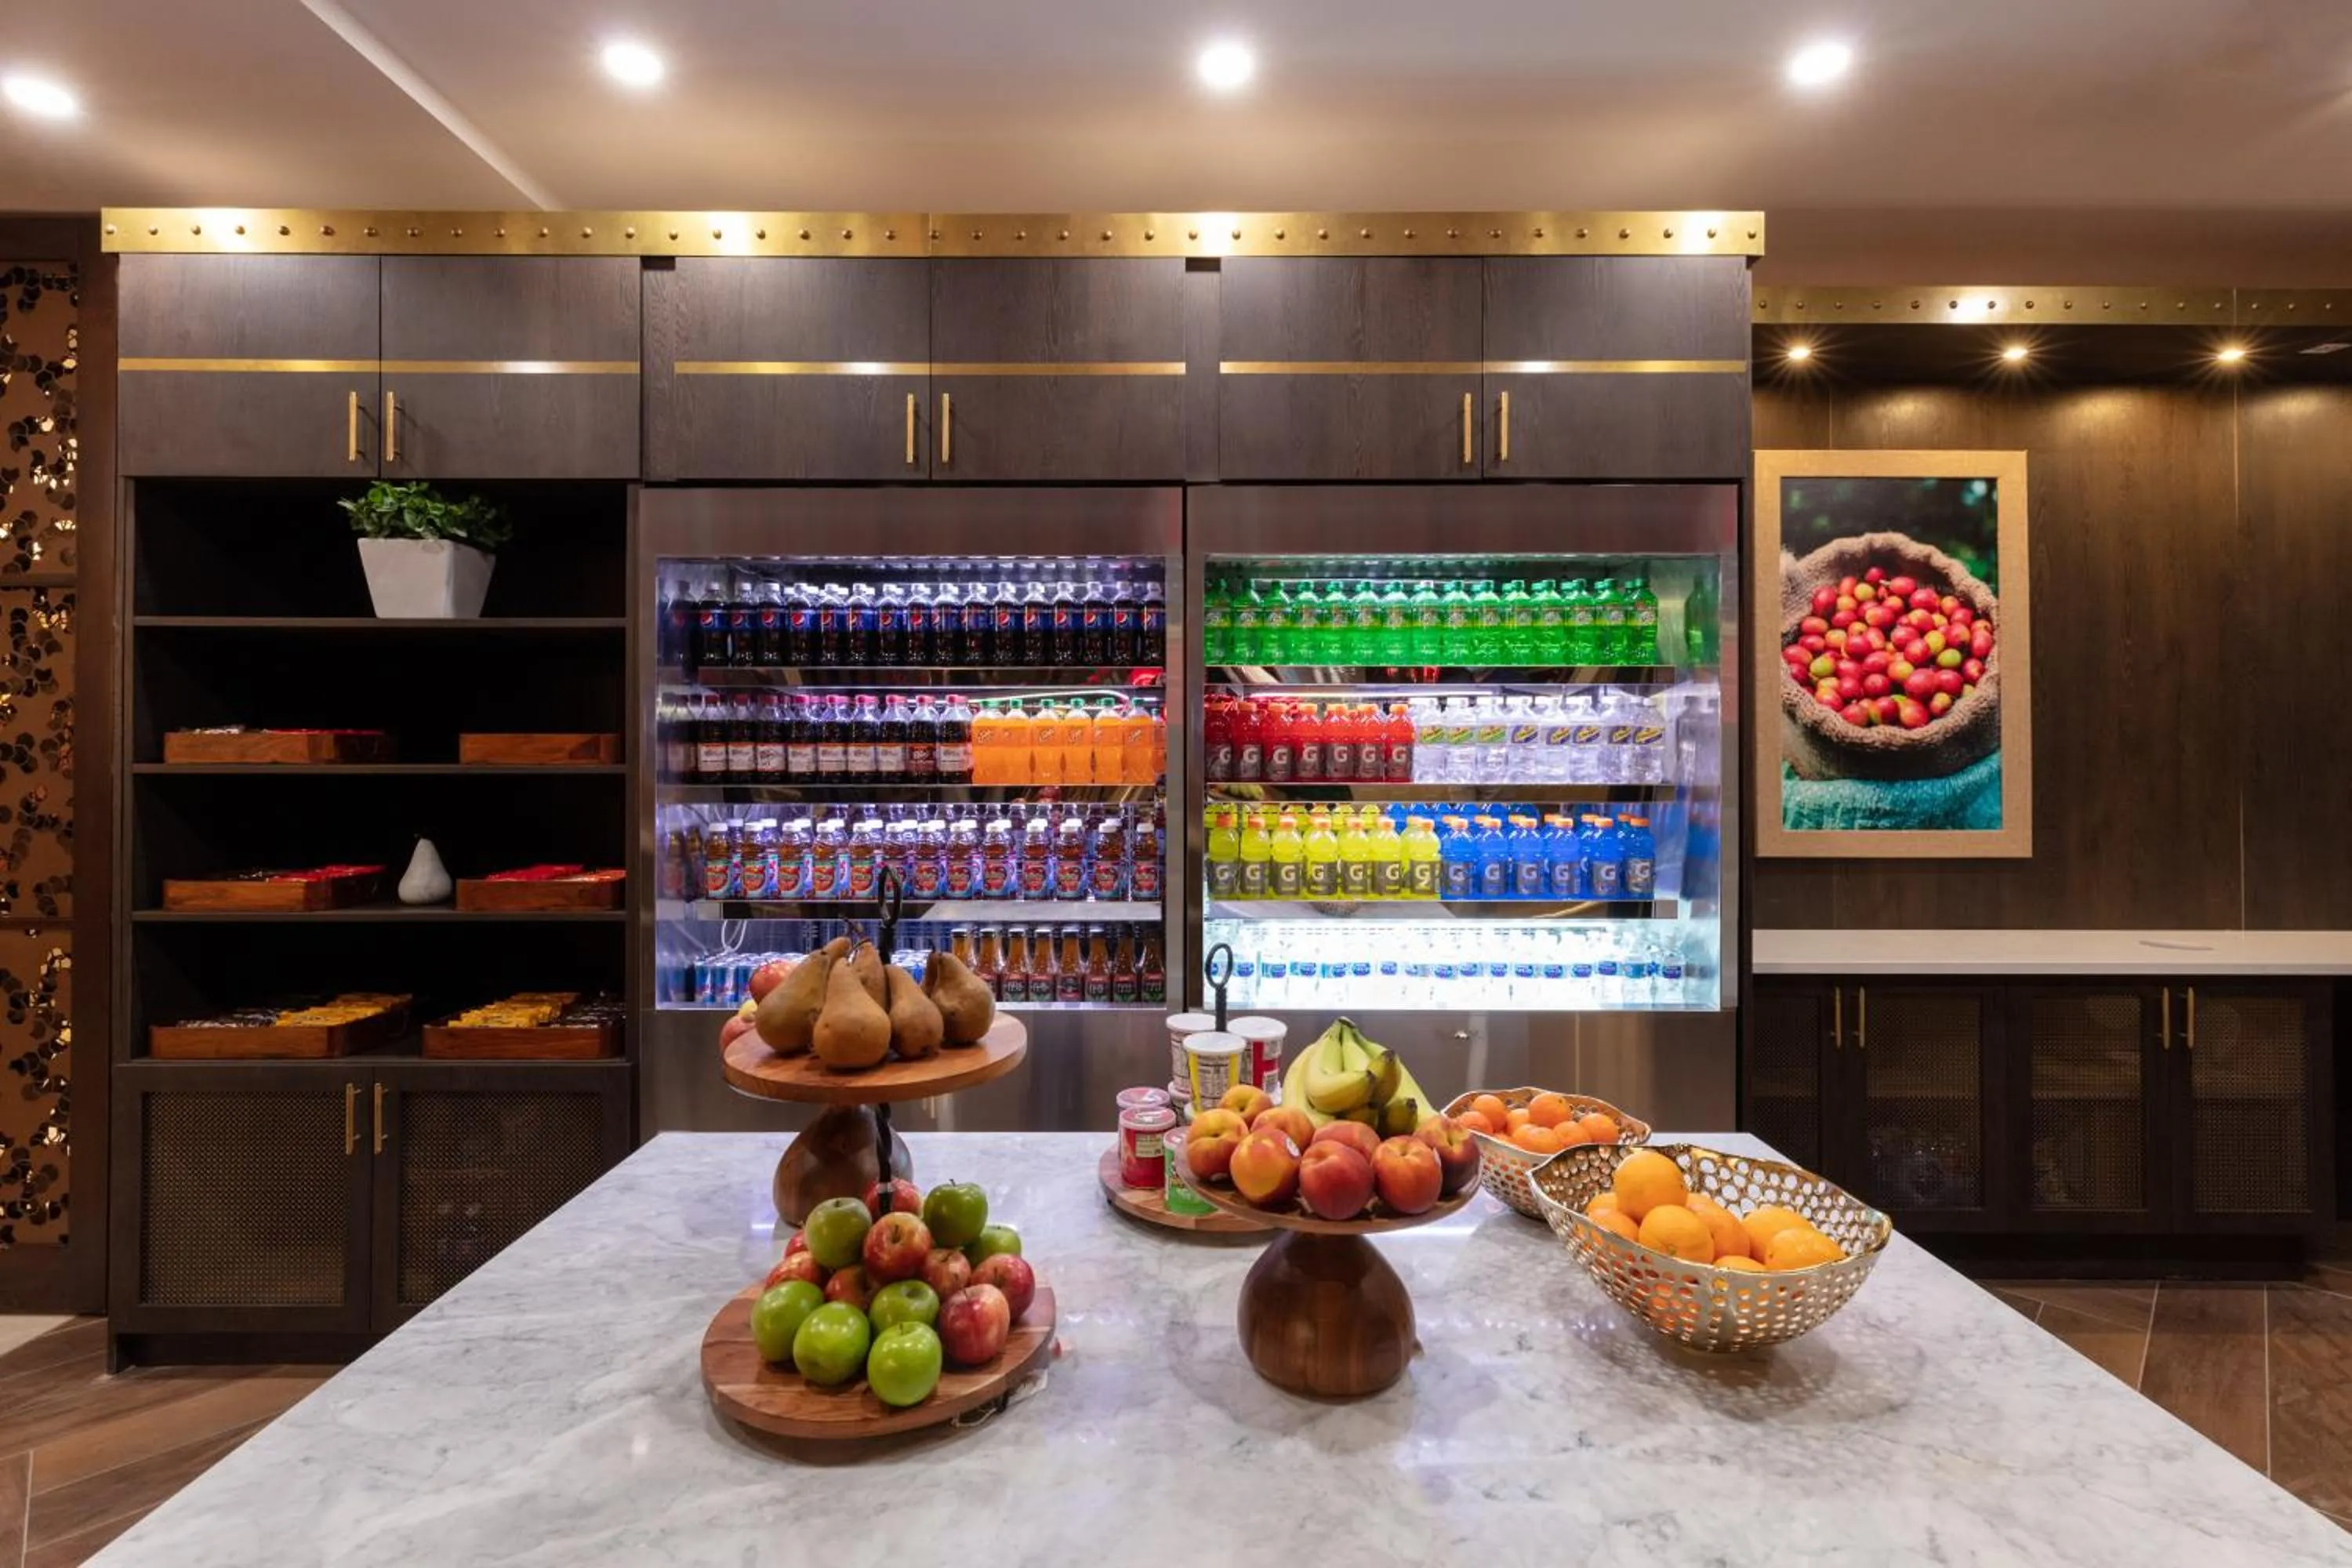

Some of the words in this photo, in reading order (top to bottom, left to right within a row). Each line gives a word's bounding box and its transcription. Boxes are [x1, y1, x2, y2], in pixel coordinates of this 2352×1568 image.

[1243, 747, 1258, 763] G
[1273, 748, 1287, 764] G
[1302, 746, 1317, 762] G
[1334, 746, 1348, 762] G
[1363, 746, 1375, 762] G
[1392, 746, 1406, 762] G
[1216, 865, 1229, 880] G
[1247, 865, 1260, 880] G
[1281, 865, 1295, 881] G
[1312, 865, 1323, 880] G
[1350, 865, 1363, 880] G
[1386, 864, 1399, 880] G
[1449, 866, 1465, 881] G
[1485, 864, 1500, 880] G
[1522, 865, 1537, 880] G
[1555, 864, 1568, 880] G
[1601, 866, 1615, 880] G
[1635, 862, 1650, 877] G
